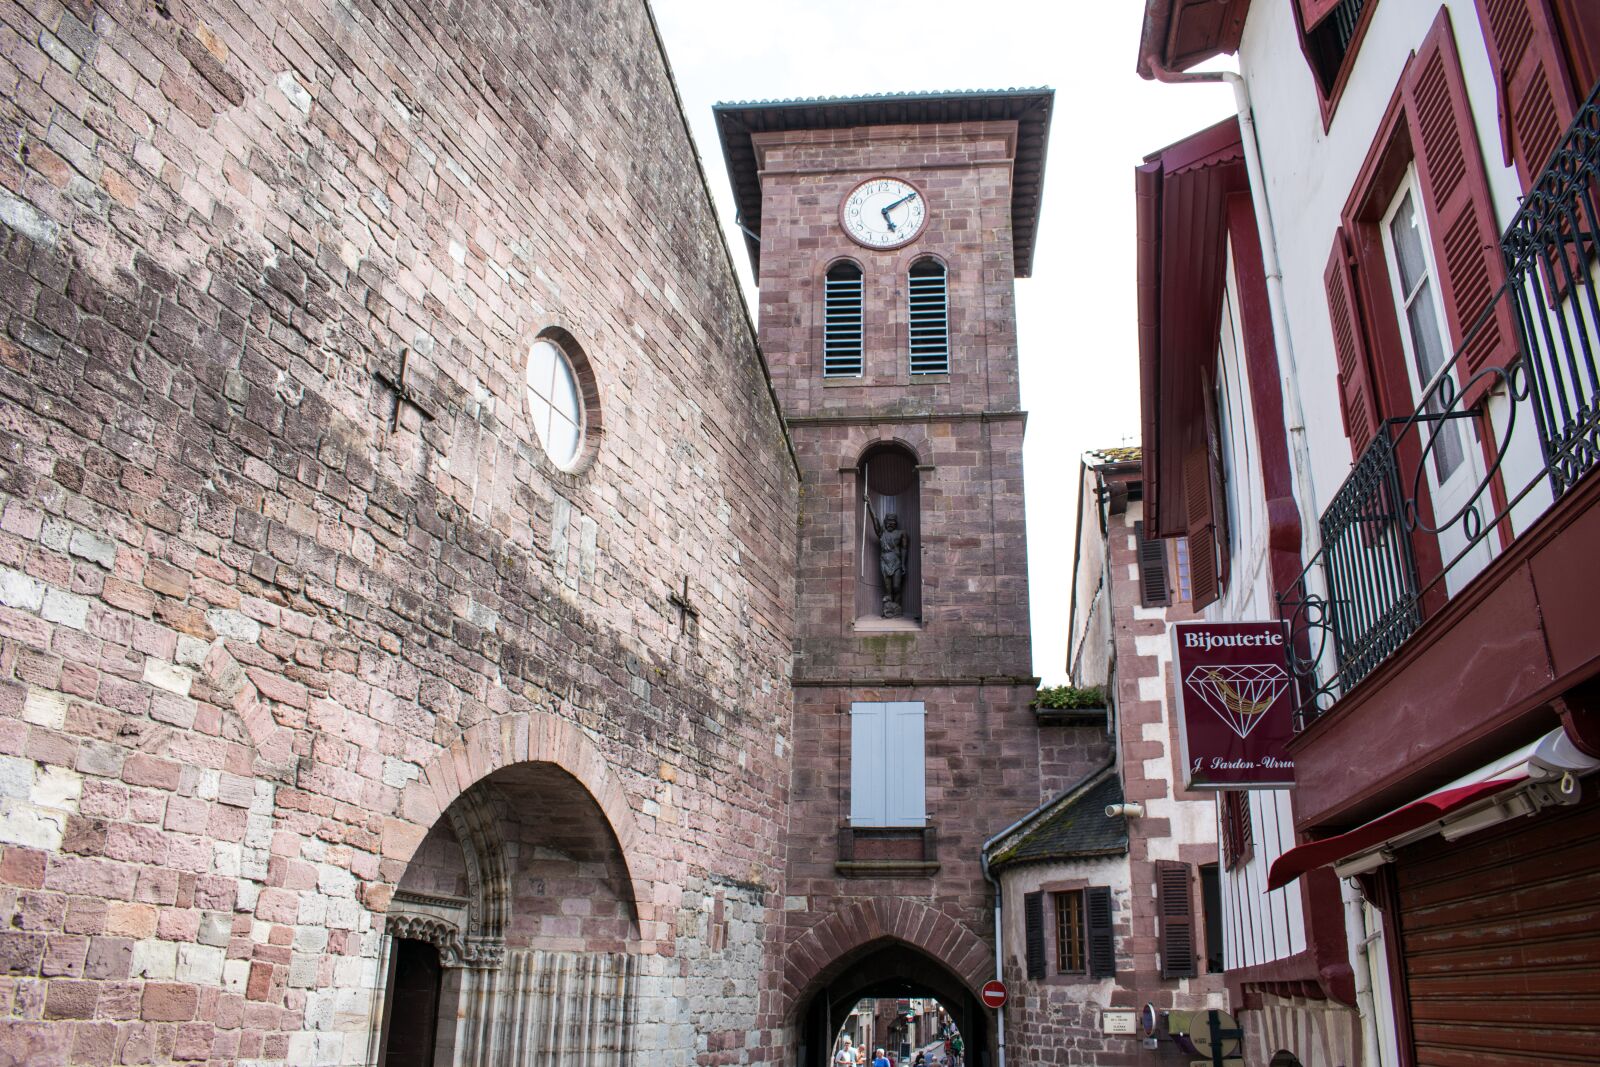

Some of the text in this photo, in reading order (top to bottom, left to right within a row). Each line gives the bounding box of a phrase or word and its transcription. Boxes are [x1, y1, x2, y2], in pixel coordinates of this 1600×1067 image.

[878, 182, 890, 192] 12
[851, 208, 859, 217] 9
[1185, 631, 1283, 651] Bijouterie
